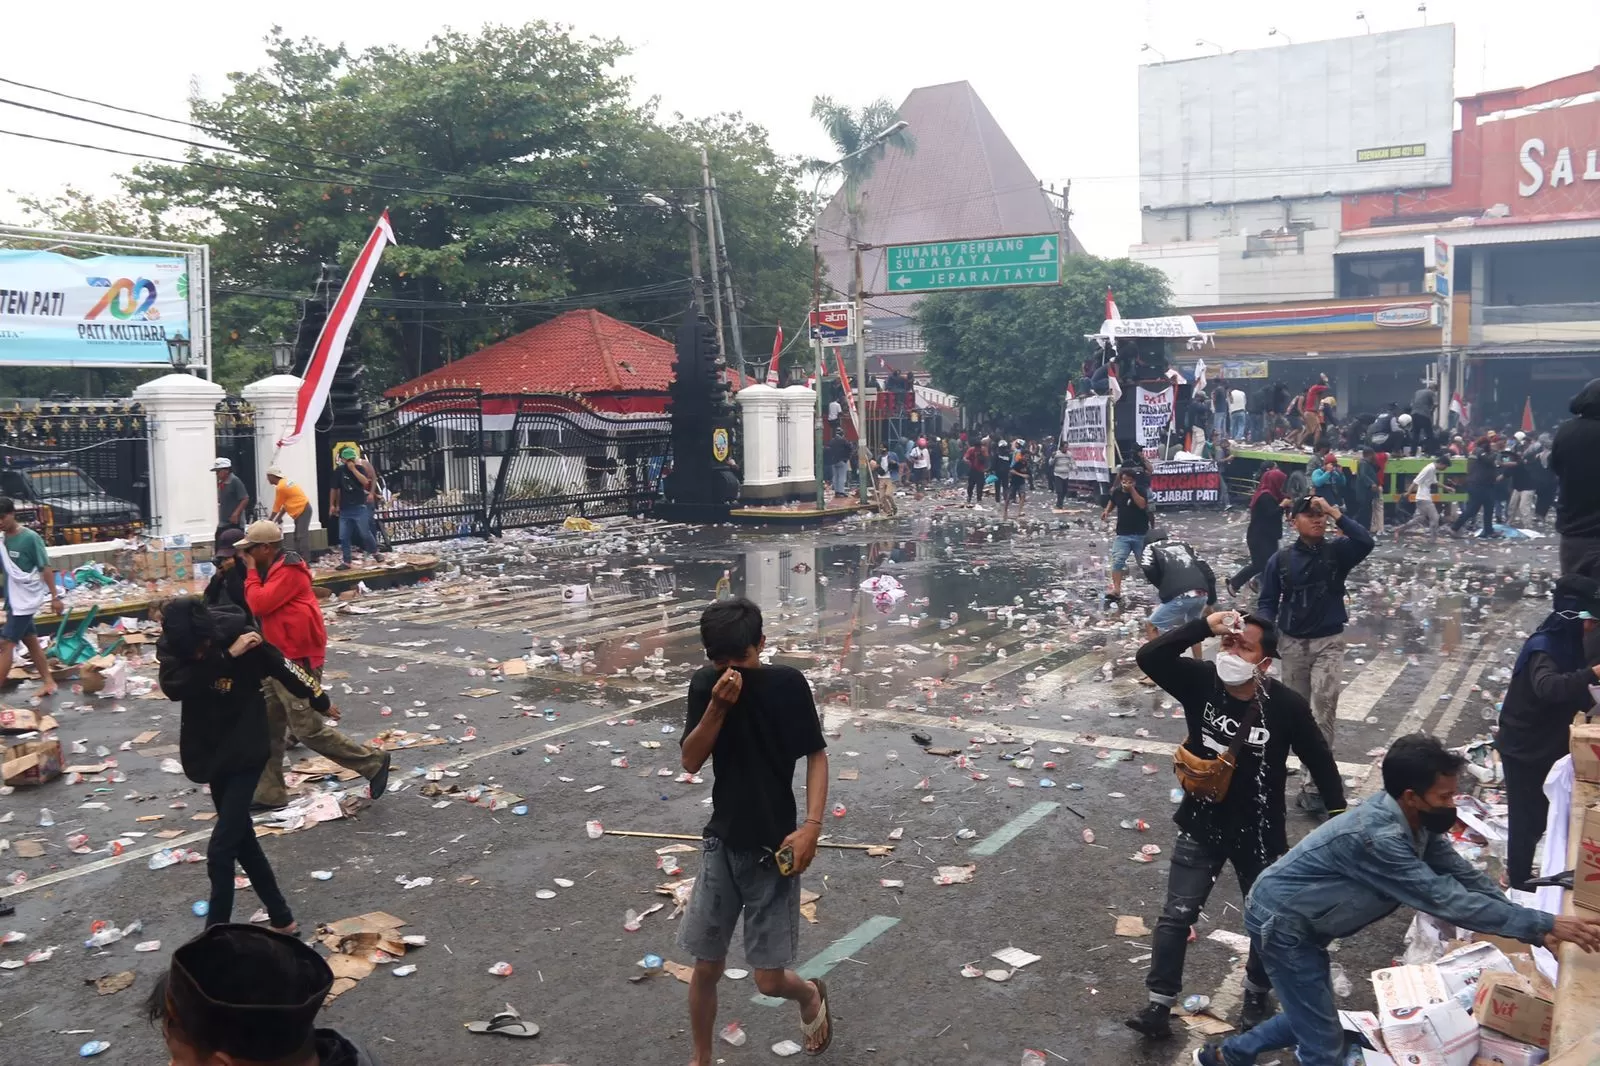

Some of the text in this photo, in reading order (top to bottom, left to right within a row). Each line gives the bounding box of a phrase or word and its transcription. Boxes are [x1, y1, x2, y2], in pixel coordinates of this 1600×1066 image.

[1519, 138, 1600, 197] SAL
[895, 239, 1024, 259] JUWANA/REMBANG
[895, 254, 992, 270] SURABAYA
[928, 267, 1048, 285] JEPARA/TAYU
[31, 291, 65, 317] PATI
[824, 312, 847, 322] atm
[78, 324, 168, 342] PATI MUTIARA
[1151, 489, 1219, 502] PEJABAT PATI
[1491, 999, 1518, 1018] Vit
